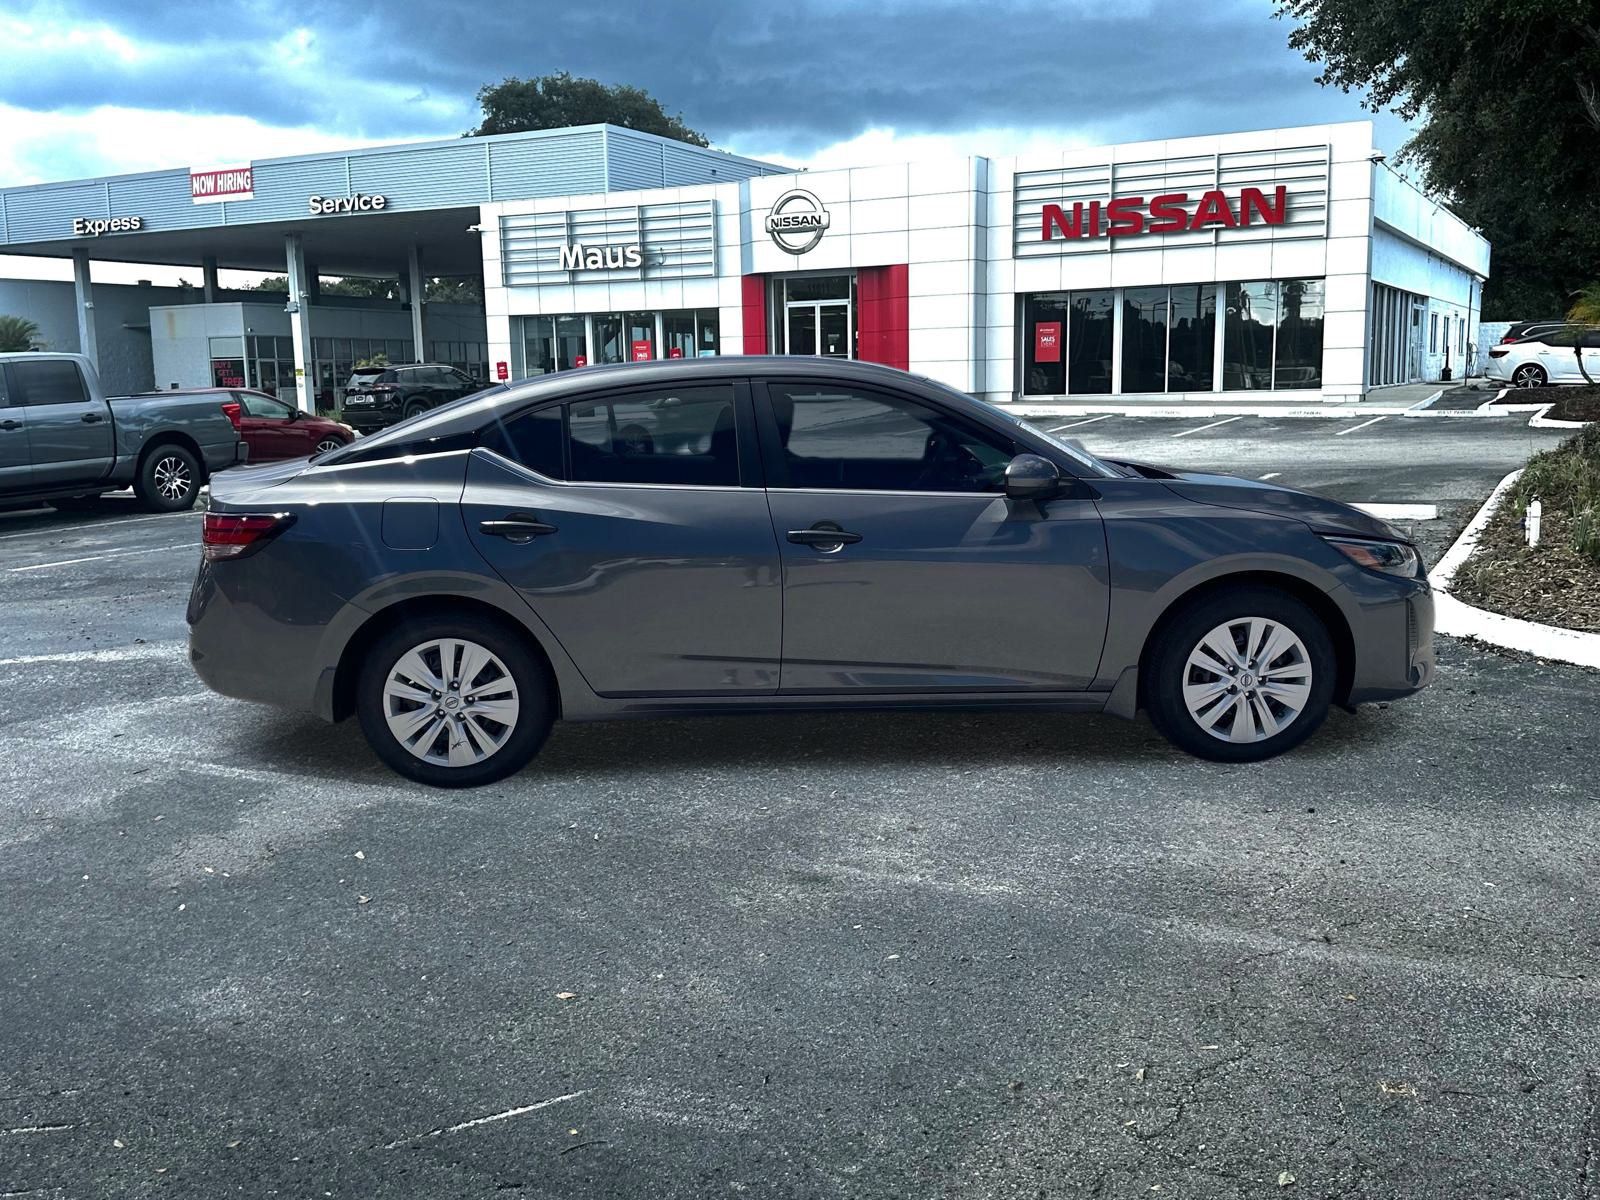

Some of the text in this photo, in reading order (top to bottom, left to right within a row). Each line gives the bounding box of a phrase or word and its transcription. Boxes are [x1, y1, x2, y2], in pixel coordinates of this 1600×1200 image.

[192, 171, 251, 195] NOW HIRING
[309, 193, 385, 215] Service
[1042, 185, 1287, 241] NISSAN
[73, 216, 141, 237] Express
[770, 214, 822, 229] NISSAN
[559, 243, 642, 270] Maus
[222, 377, 244, 387] FREE
